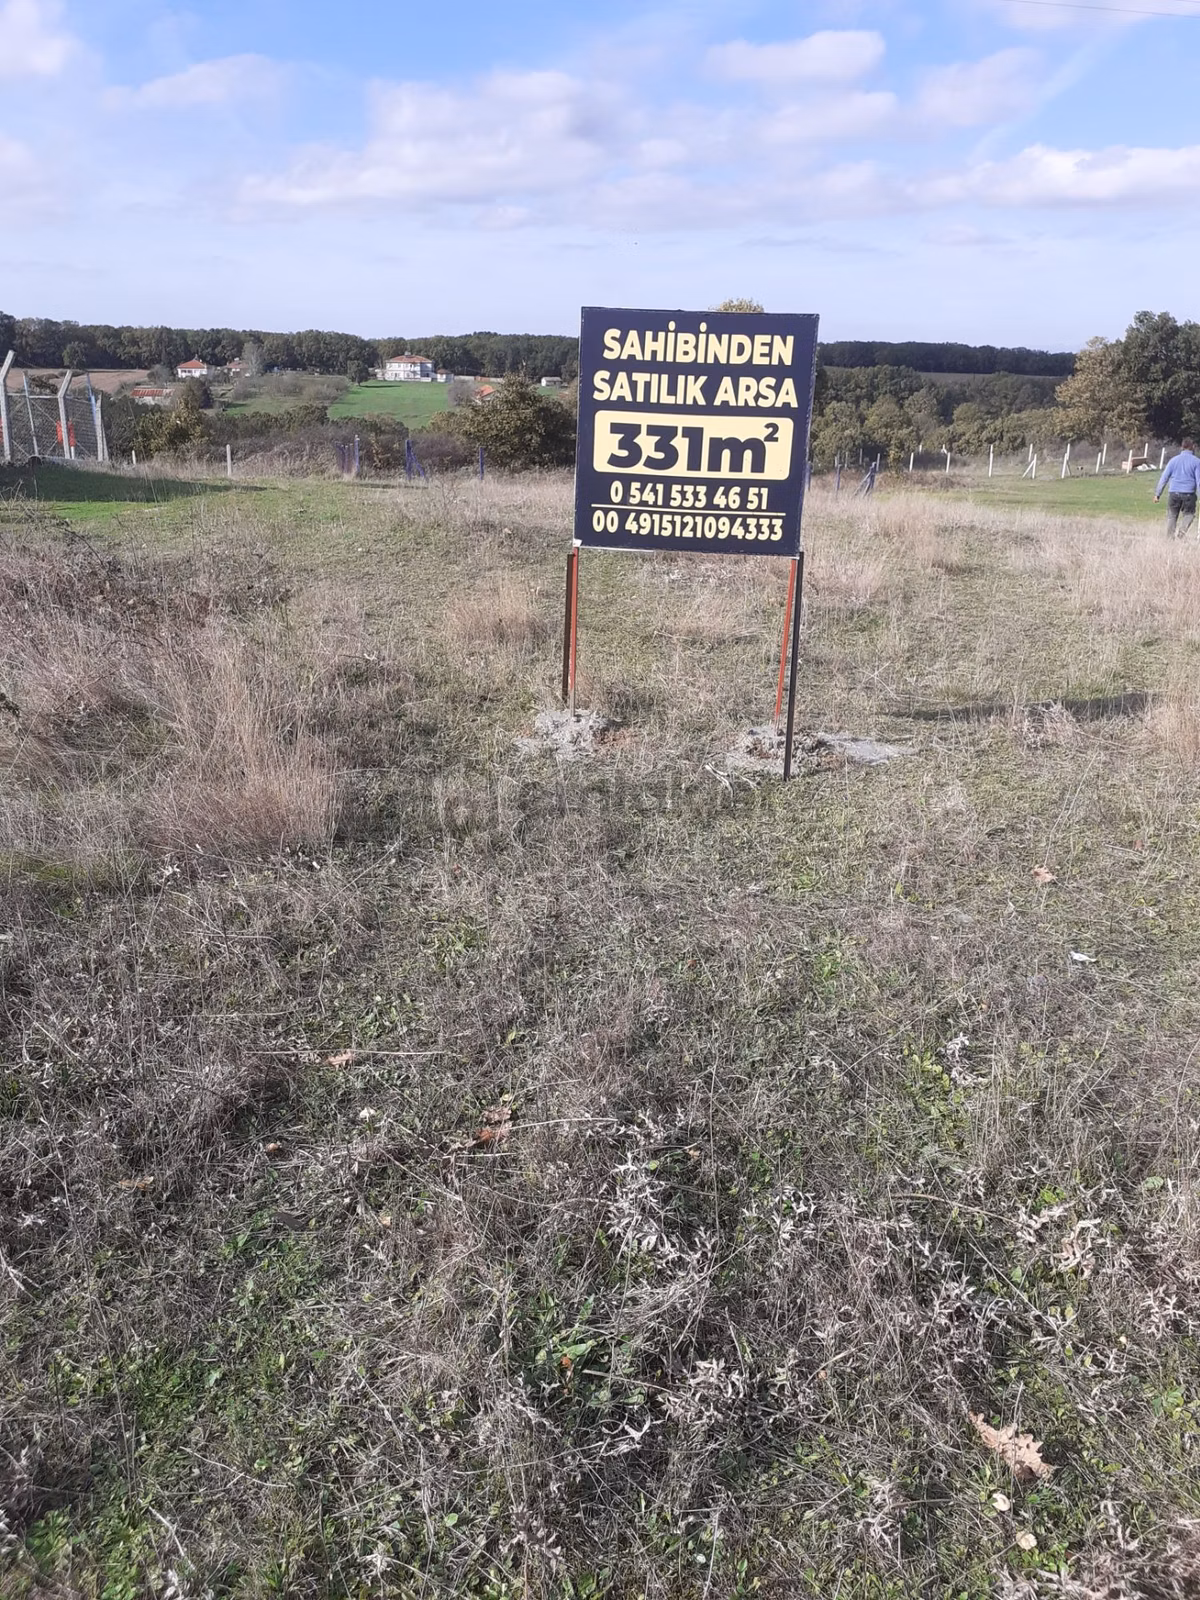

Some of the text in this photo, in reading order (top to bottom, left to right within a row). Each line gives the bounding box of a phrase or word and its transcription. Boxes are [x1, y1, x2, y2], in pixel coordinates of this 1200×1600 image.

[603, 321, 795, 366] SAHİBİNDEN
[592, 370, 798, 408] SATILIK ARSA
[607, 422, 779, 474] 331m²
[610, 480, 768, 510] 0 541 533 46 51
[592, 509, 783, 542] 00 4915121094333
